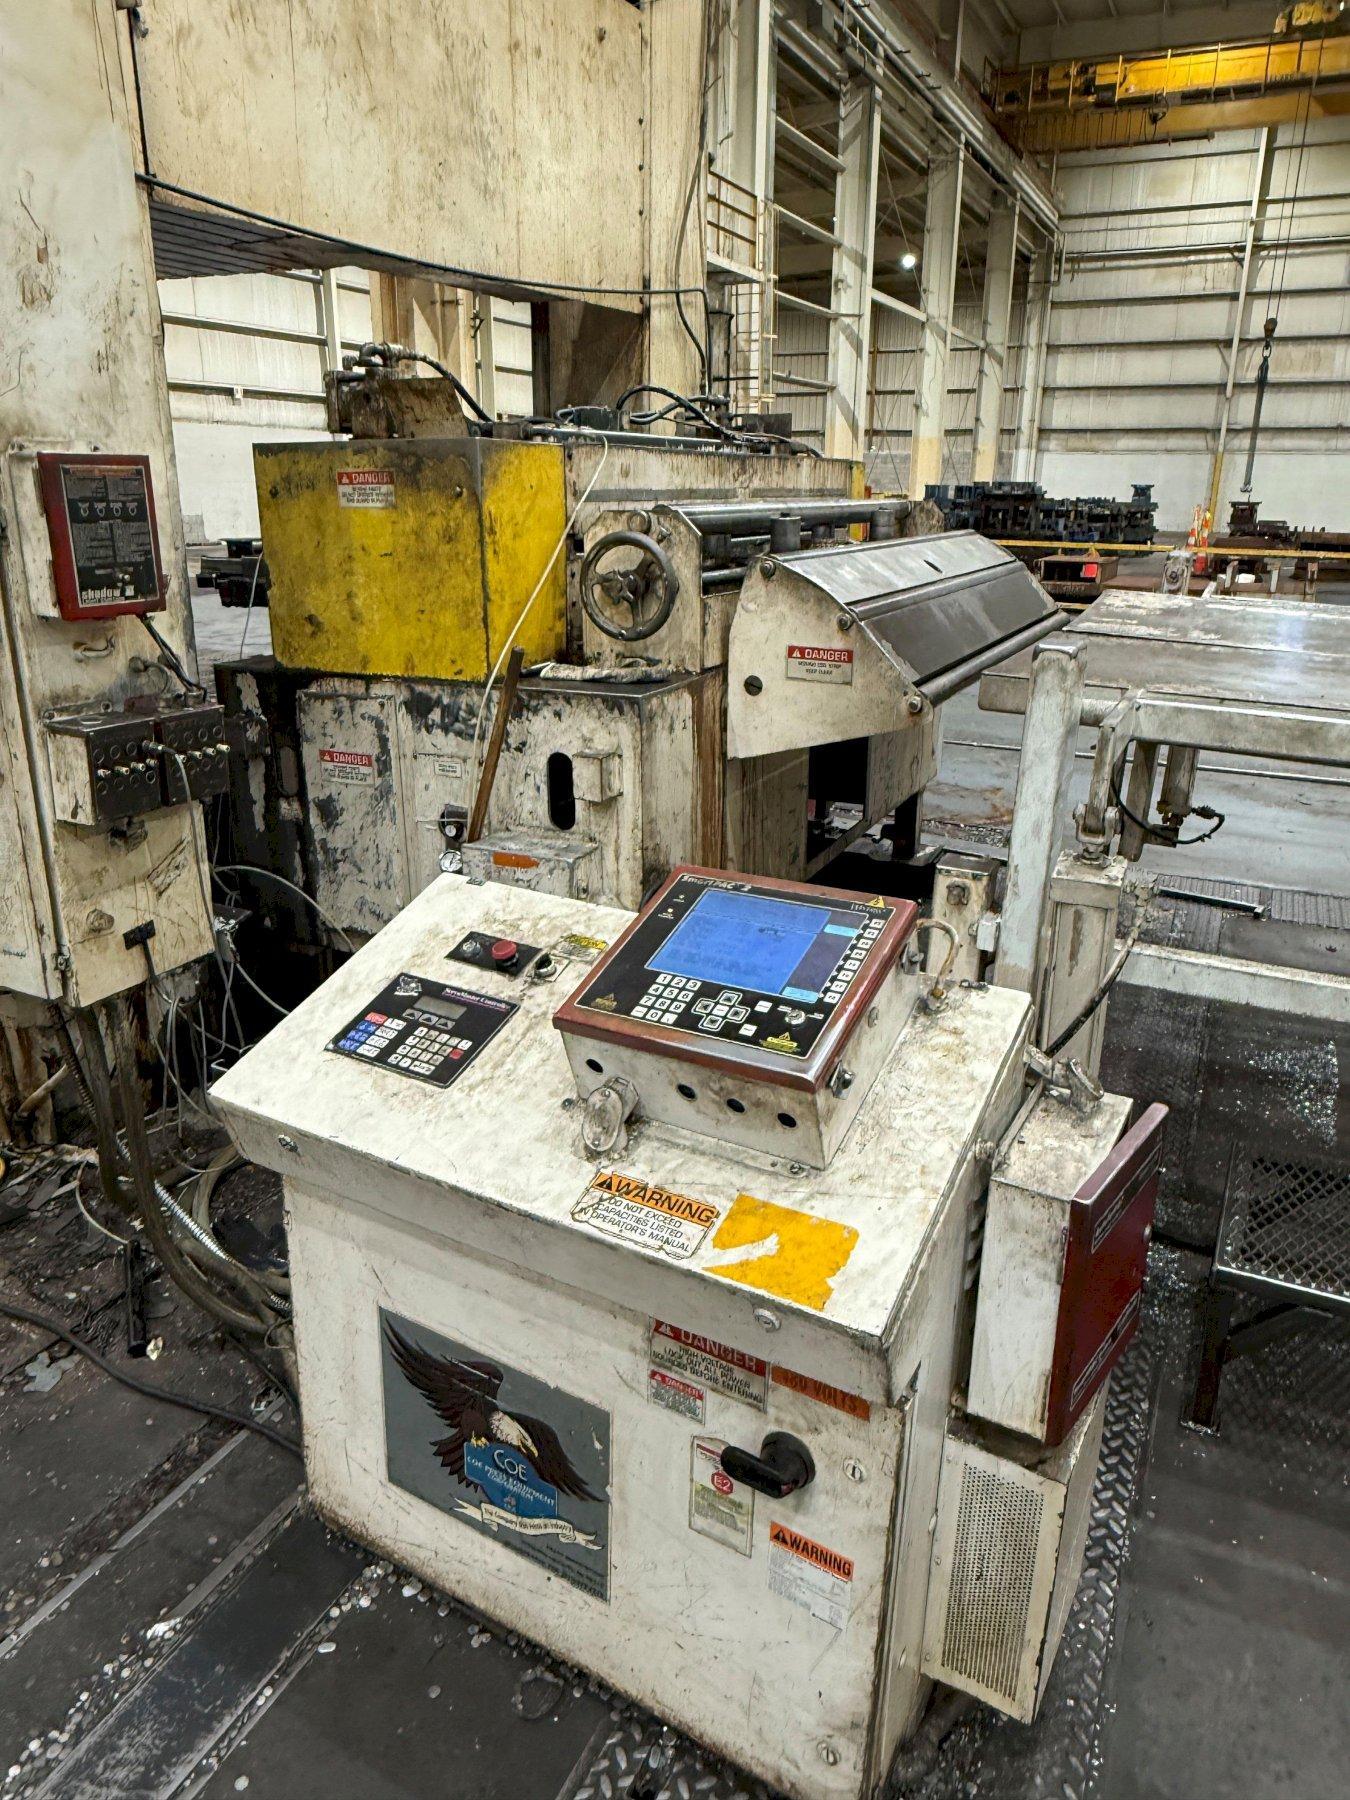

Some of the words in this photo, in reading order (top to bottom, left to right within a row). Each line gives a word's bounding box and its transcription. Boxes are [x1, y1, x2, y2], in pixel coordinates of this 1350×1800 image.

[352, 472, 391, 484] DANGER
[804, 648, 848, 661] DANGER
[333, 754, 368, 765] DANGER
[608, 1198, 622, 1207] DO
[625, 1203, 644, 1214] NOT
[645, 1210, 682, 1228] EXCEED
[615, 1178, 716, 1223] WARNING
[592, 1210, 646, 1236] OPERATOR'S
[648, 1232, 690, 1253] MANUAL
[596, 1203, 648, 1227] CAPACITIES
[650, 1222, 683, 1239] LISTED
[681, 1329, 757, 1373] DANGER
[494, 1450, 528, 1481] COE
[789, 1534, 851, 1578] WARNING
